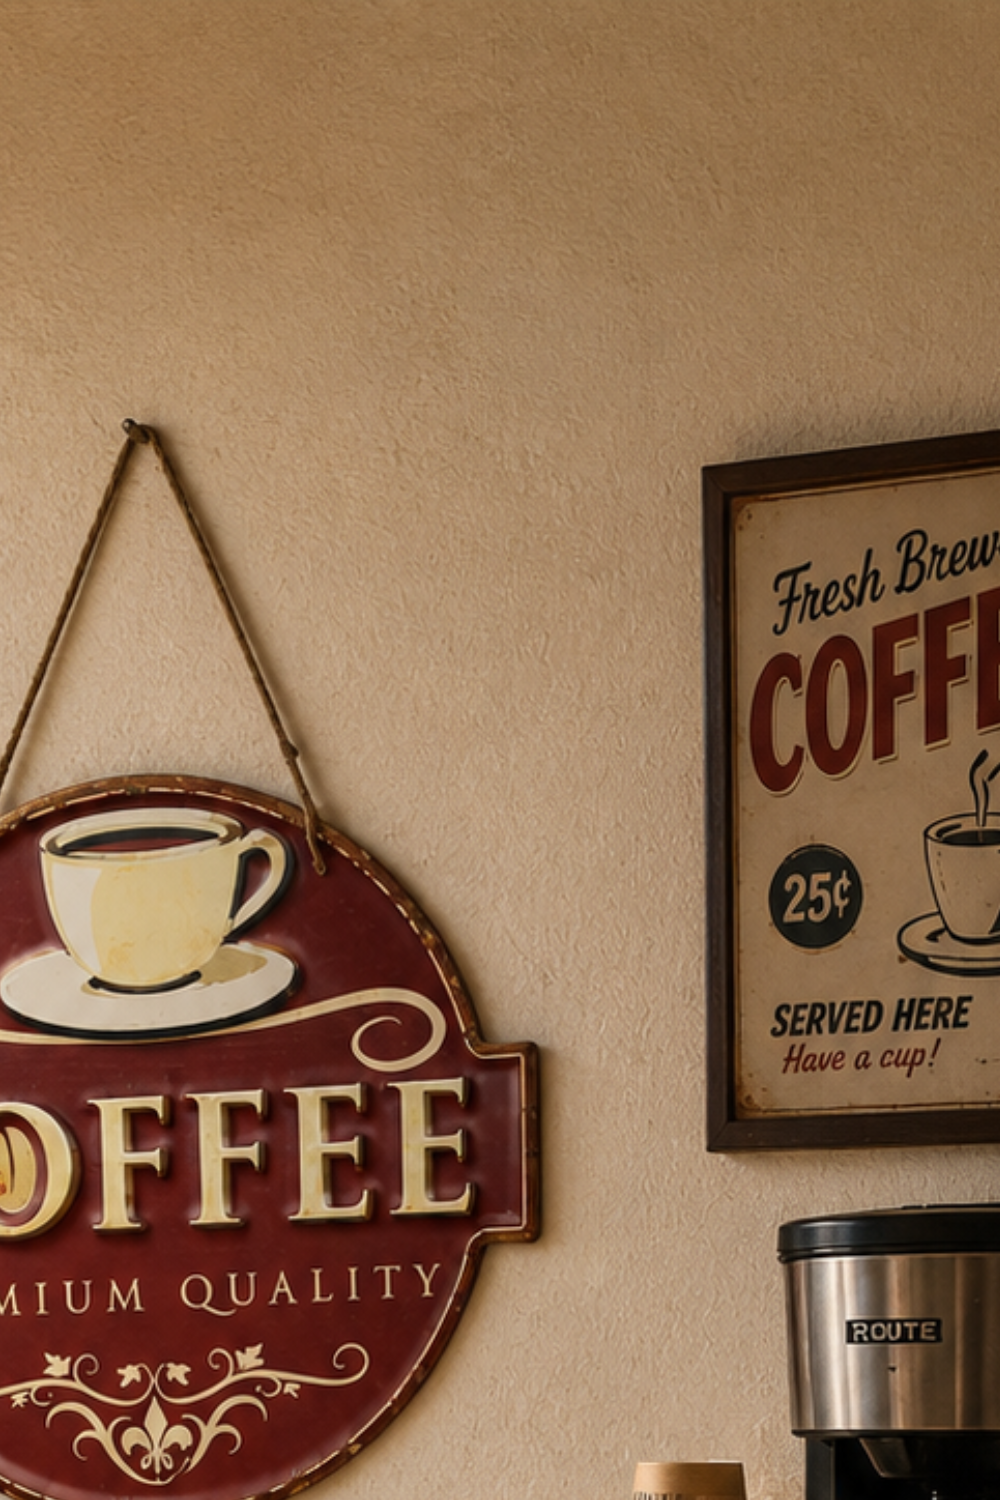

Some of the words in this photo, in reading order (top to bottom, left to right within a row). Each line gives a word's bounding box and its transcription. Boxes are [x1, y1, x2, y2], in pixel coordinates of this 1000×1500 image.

[772, 548, 885, 636] Fresh
[782, 869, 852, 924] 25¢
[770, 999, 884, 1037] SERVED
[891, 995, 974, 1032] HERE
[782, 1042, 846, 1074] Have
[854, 1049, 872, 1070] a
[879, 1037, 942, 1079] cup!
[179, 1262, 443, 1317] QUALITY
[851, 1321, 937, 1342] ROUTE
